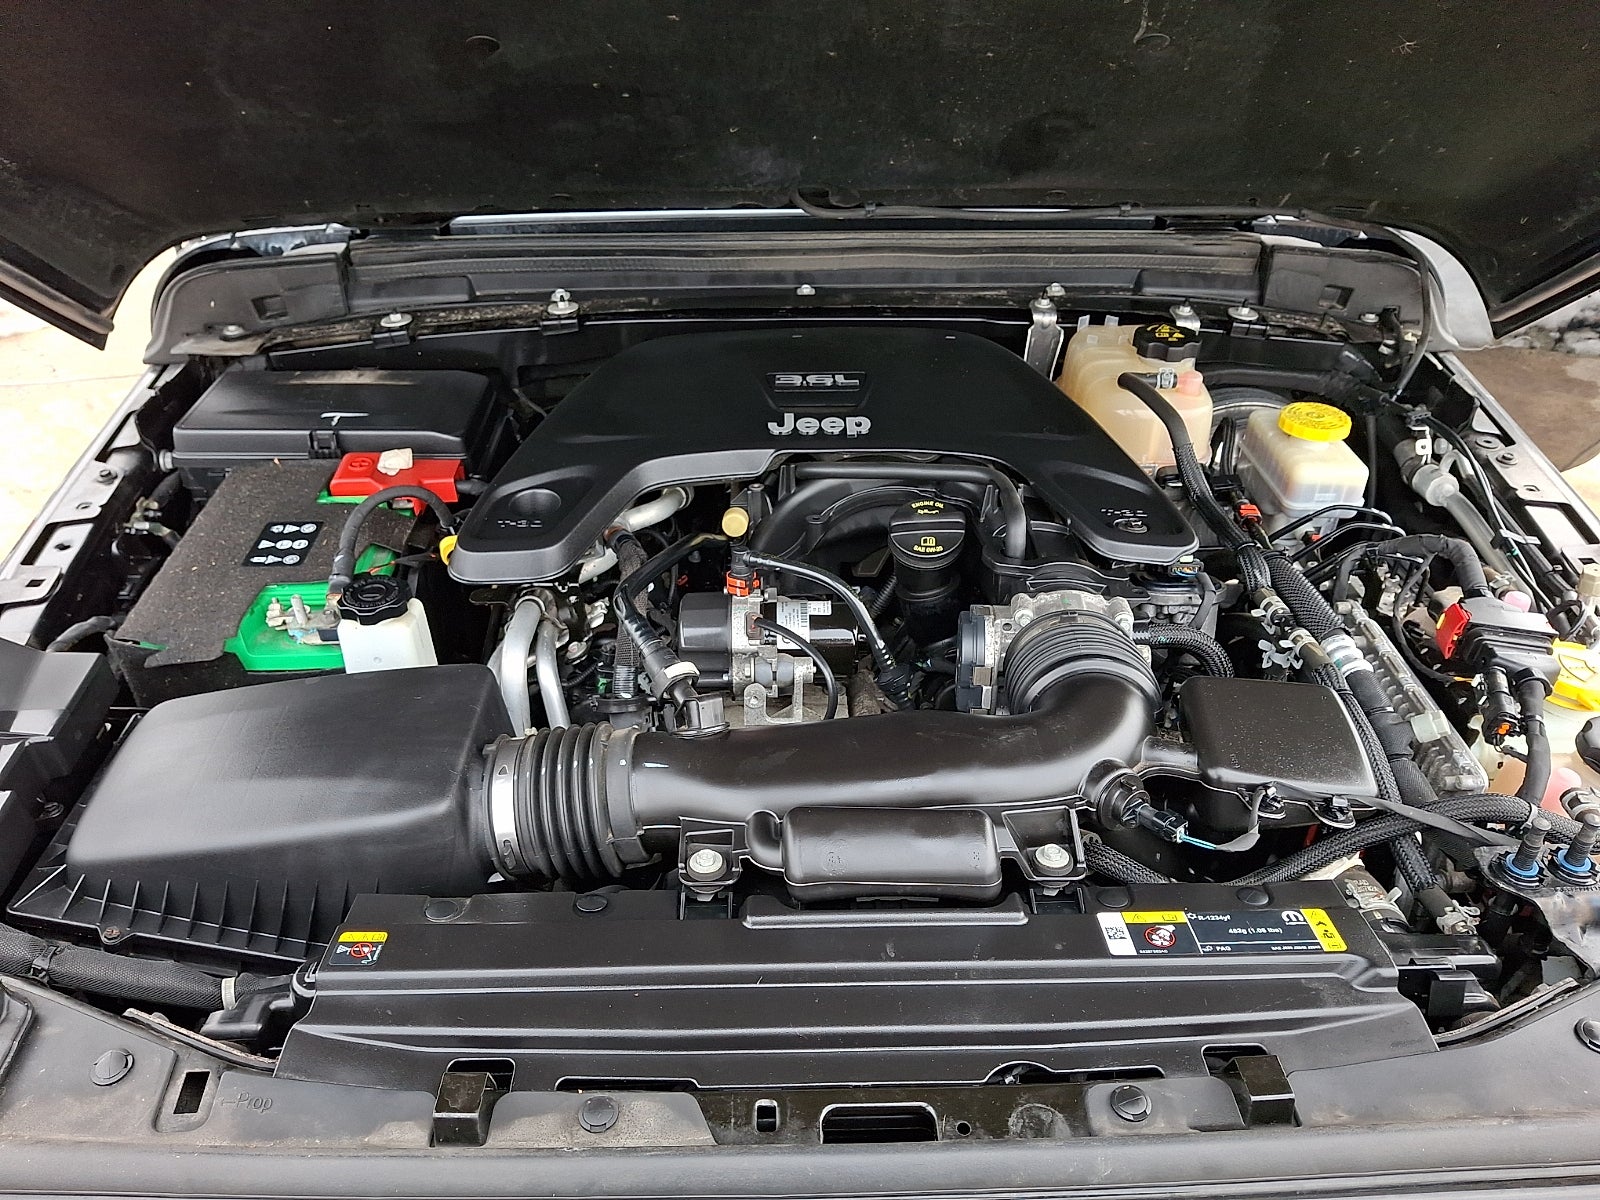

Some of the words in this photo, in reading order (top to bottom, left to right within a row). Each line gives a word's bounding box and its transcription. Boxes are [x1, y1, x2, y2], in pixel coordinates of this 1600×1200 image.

[774, 374, 860, 387] 3.6L
[767, 412, 872, 438] Jeep
[911, 500, 934, 509] ENGINE
[934, 501, 944, 509] OIL
[913, 544, 926, 553] SAE
[236, 1090, 273, 1114] Prop
